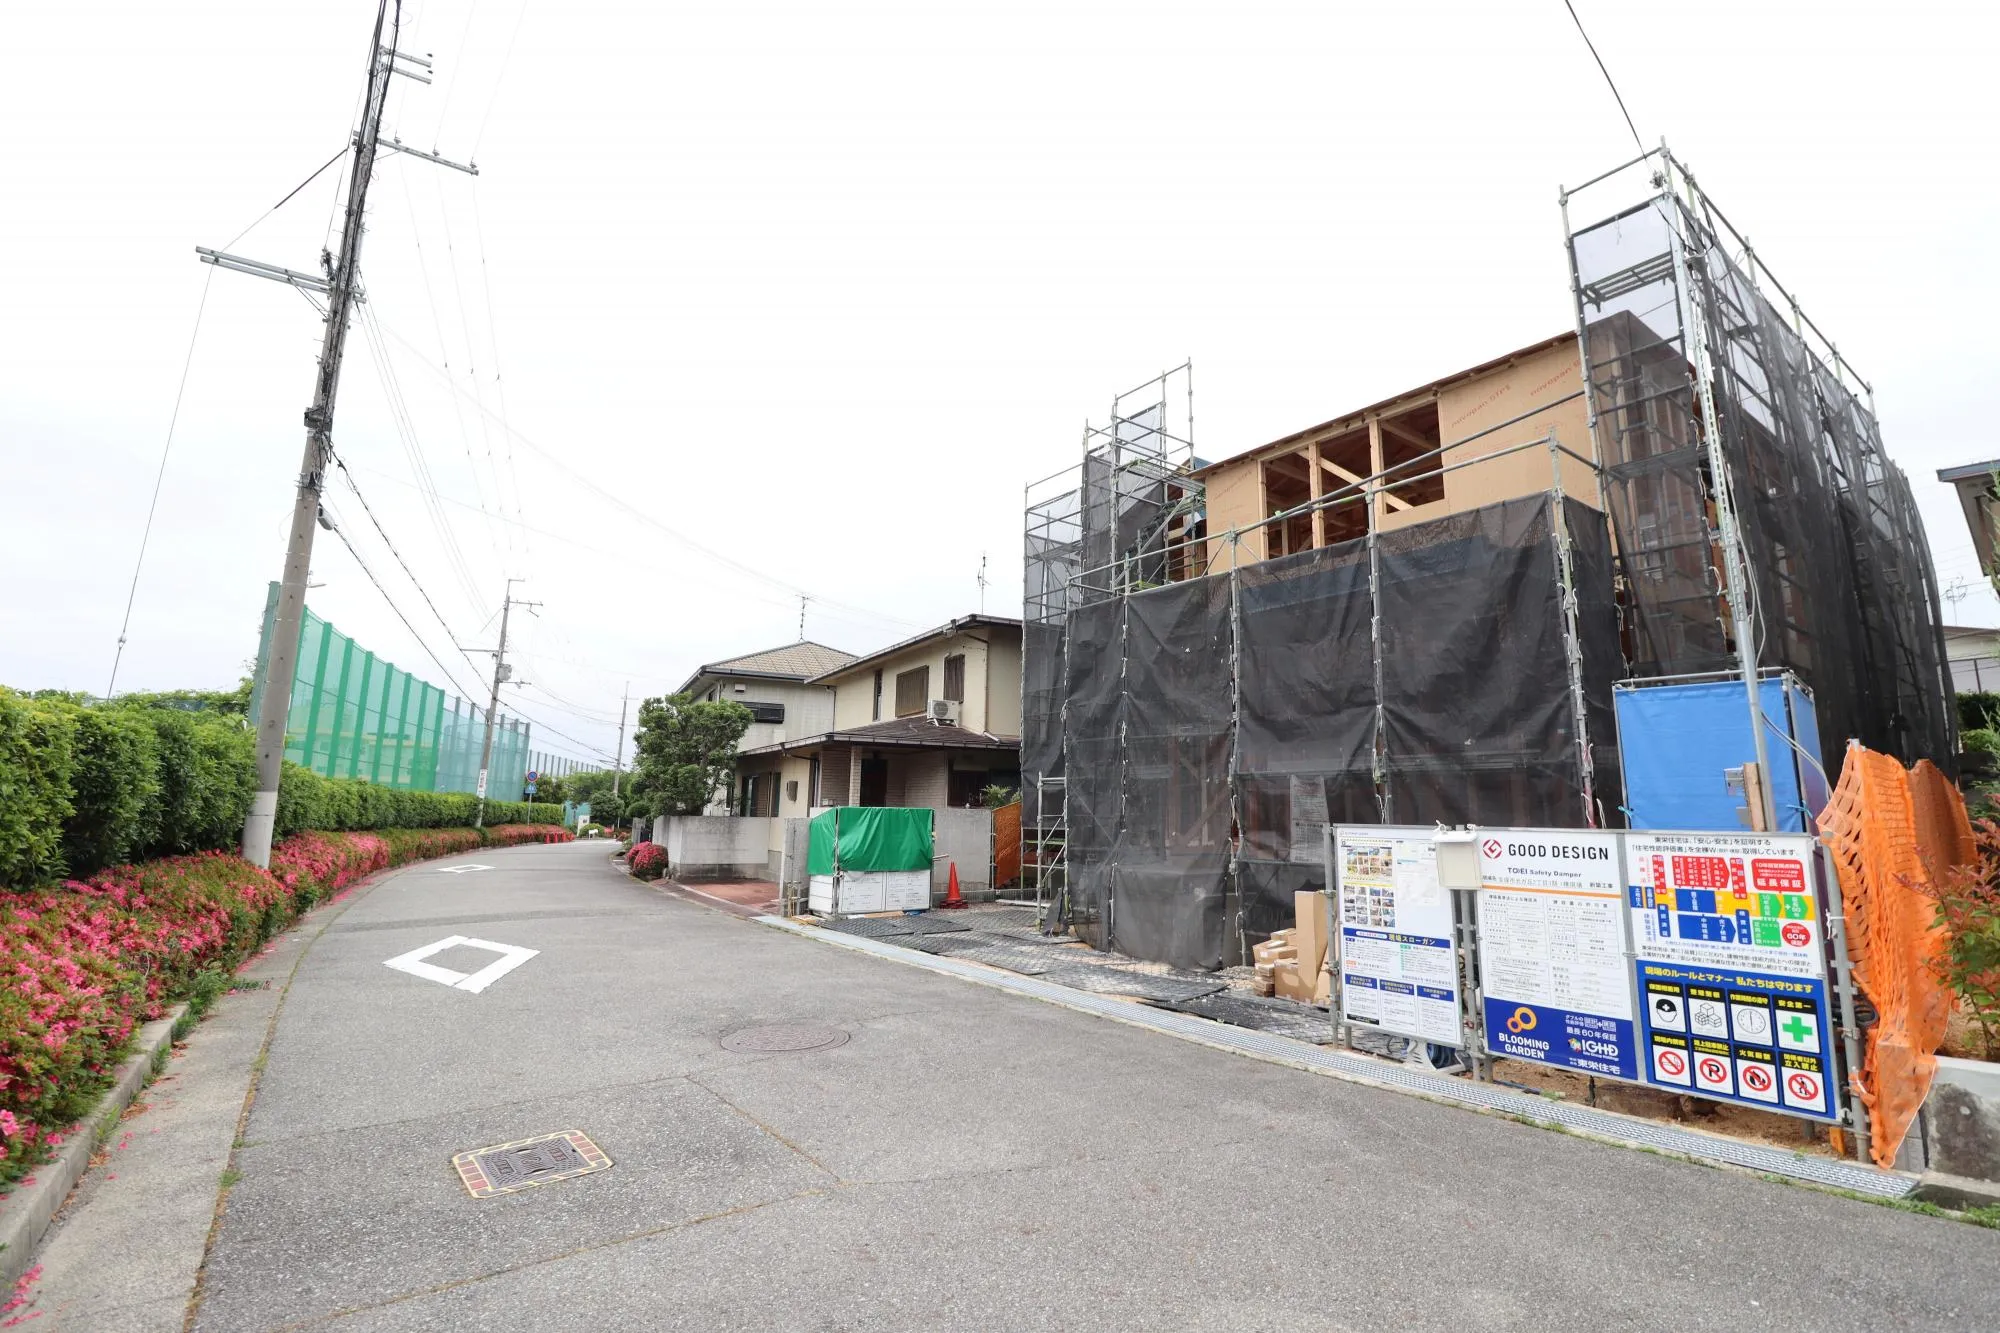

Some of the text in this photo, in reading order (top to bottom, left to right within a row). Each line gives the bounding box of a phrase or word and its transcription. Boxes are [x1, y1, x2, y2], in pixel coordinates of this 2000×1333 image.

[1529, 366, 1572, 396] novopan
[1508, 843, 1609, 860] GOOD DESIGN
[1530, 869, 1551, 877] Safety
[1554, 870, 1581, 878] Damper
[1756, 878, 1802, 888] 延長保証
[1645, 965, 1813, 993] 現場のルールとマナー 私たちは守ります
[1778, 1000, 1811, 1009] 安全第一
[1498, 1032, 1550, 1051] BLOOMING
[1654, 1035, 1685, 1046] 現場内禁煙
[1504, 1043, 1545, 1060] GARDEN
[1738, 1049, 1771, 1060] 火気厳禁
[1783, 1053, 1816, 1064] 関係者以外
[1577, 1059, 1620, 1075] 東栄住宅
[1785, 1060, 1818, 1072] 立入禁止
